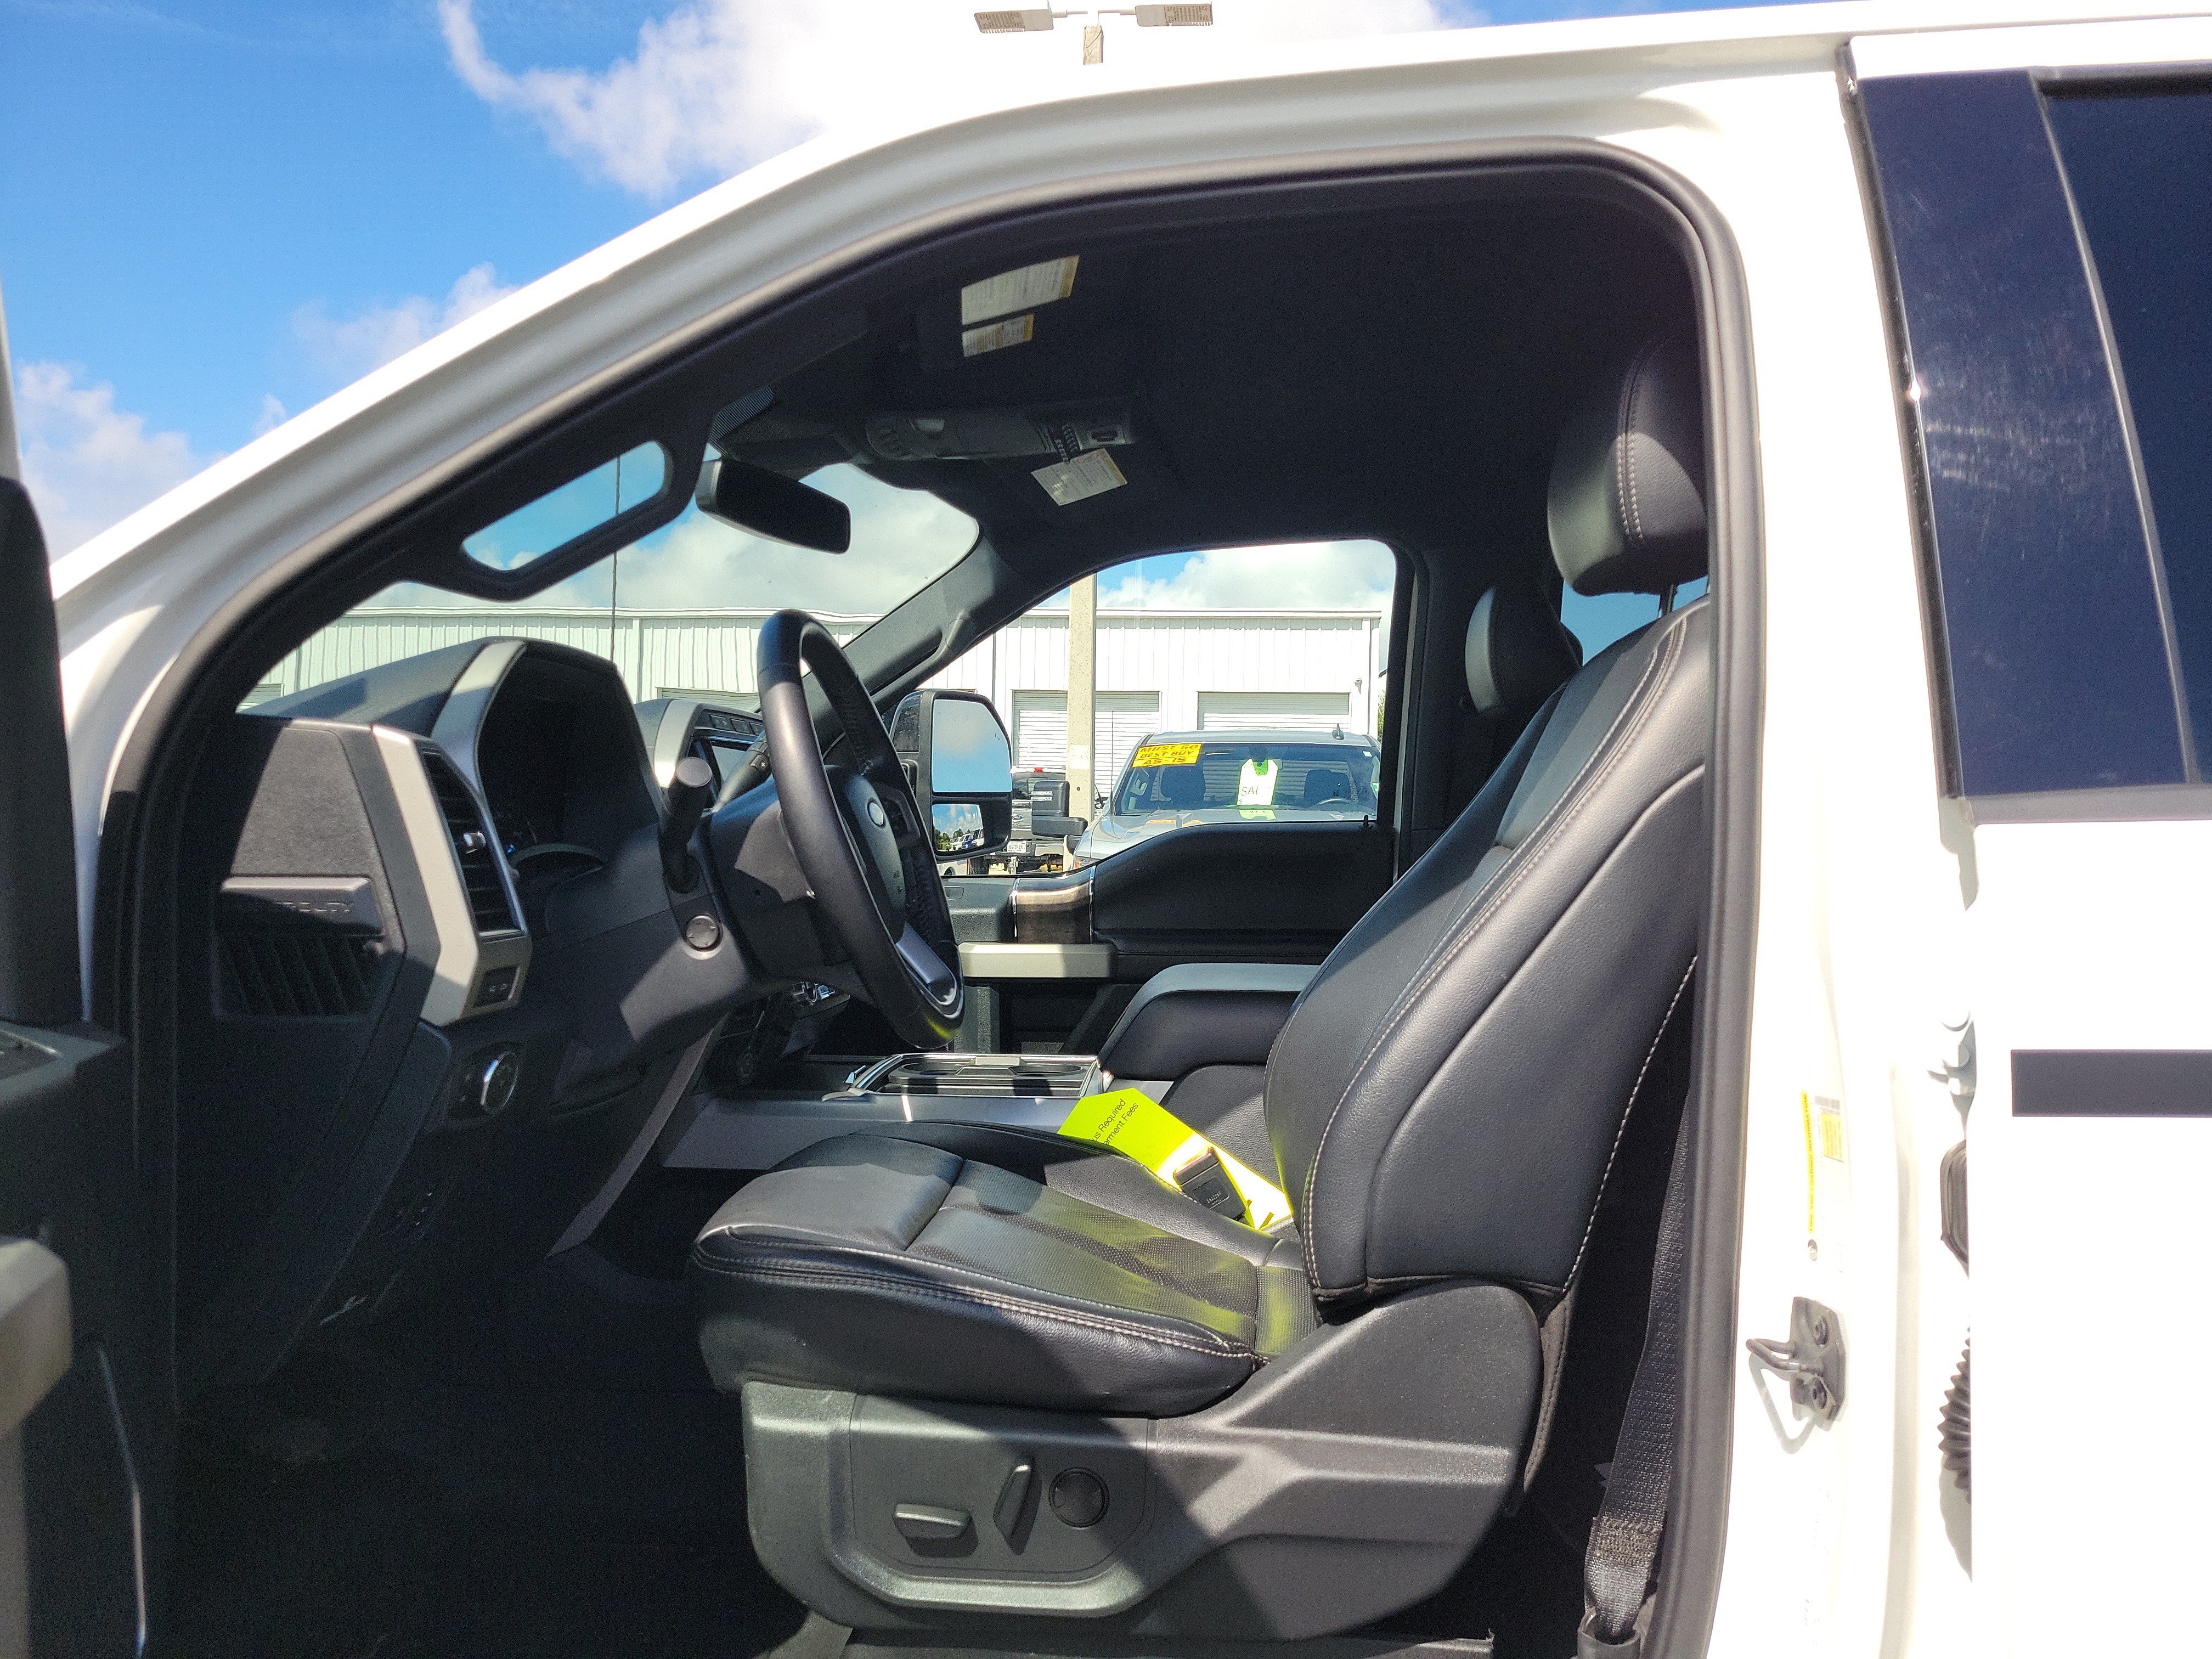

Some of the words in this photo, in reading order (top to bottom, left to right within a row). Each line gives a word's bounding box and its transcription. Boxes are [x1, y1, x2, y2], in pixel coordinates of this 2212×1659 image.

[1241, 786, 1257, 795] SAL
[1091, 1132, 1101, 1142] us
[1098, 1098, 1126, 1132] Required
[1103, 1120, 1125, 1146] erment
[1121, 1103, 1138, 1122] Fees
